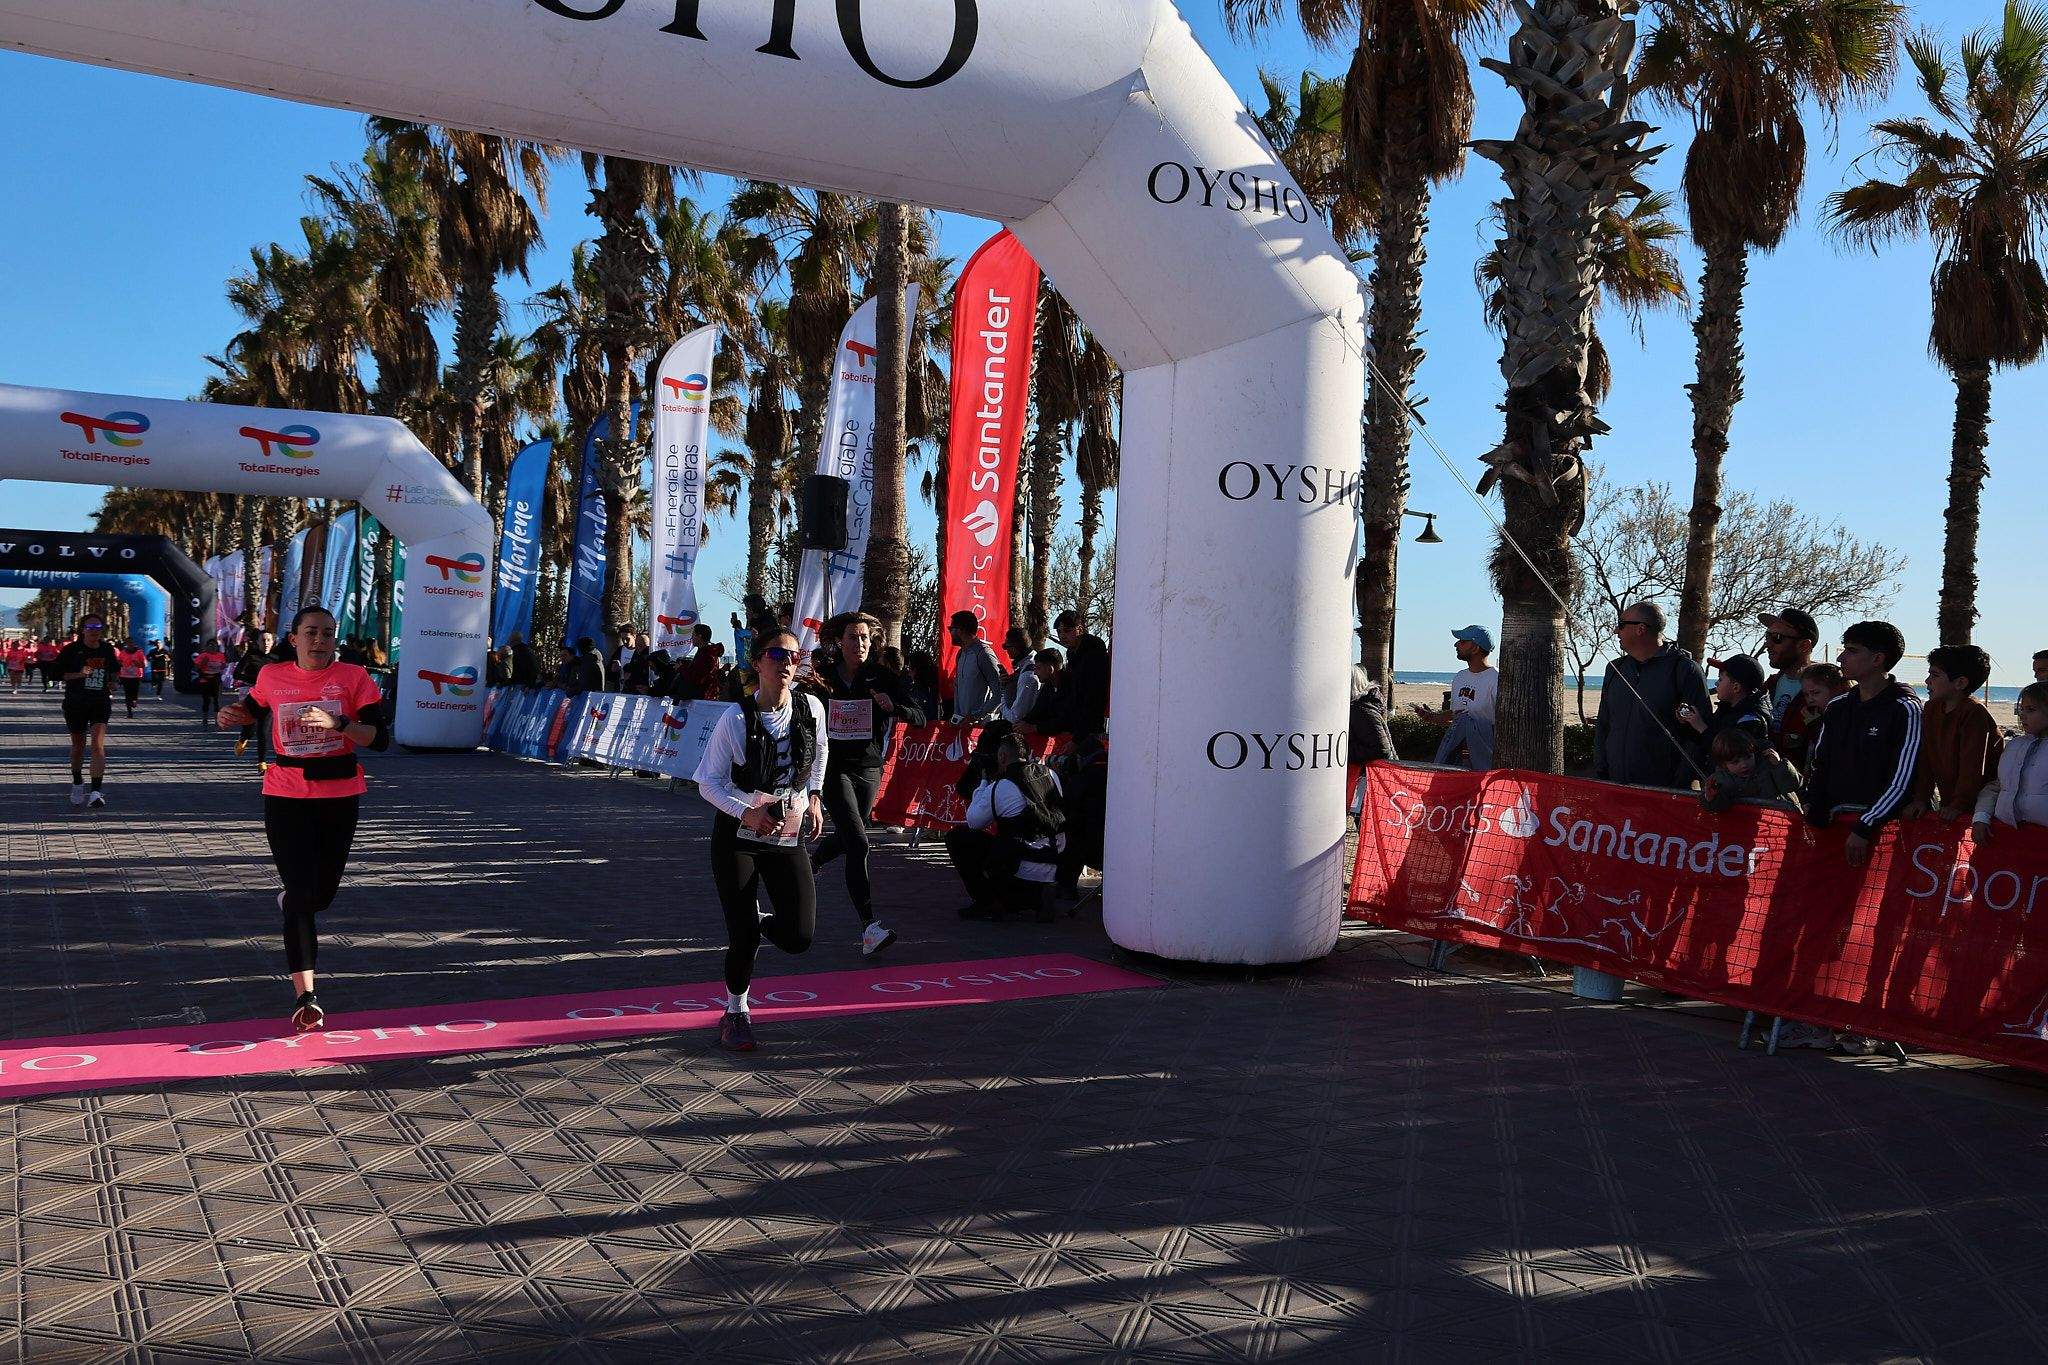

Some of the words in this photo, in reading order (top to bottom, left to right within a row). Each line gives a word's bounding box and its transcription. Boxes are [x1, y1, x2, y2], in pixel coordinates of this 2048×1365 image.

[1147, 161, 1309, 224] OYSHO
[971, 288, 1013, 494] Santander
[59, 449, 151, 466] TotalEnergies
[238, 462, 320, 477] TotalEnergies
[1218, 461, 1360, 506] OYSHO
[0, 543, 137, 559] VOLVO
[499, 500, 537, 592] Marlene
[423, 585, 485, 599] TotalEnergies
[965, 555, 994, 645] ports
[415, 700, 478, 713] TotalEnergies
[900, 735, 945, 767] Sports
[1206, 731, 1348, 771] OYSHO
[1386, 791, 1493, 839] Sports
[1543, 806, 1770, 879] Santander
[870, 967, 1083, 995] OYSHO
[566, 990, 818, 1021] OYSO
[187, 1019, 498, 1056] OYSHO
